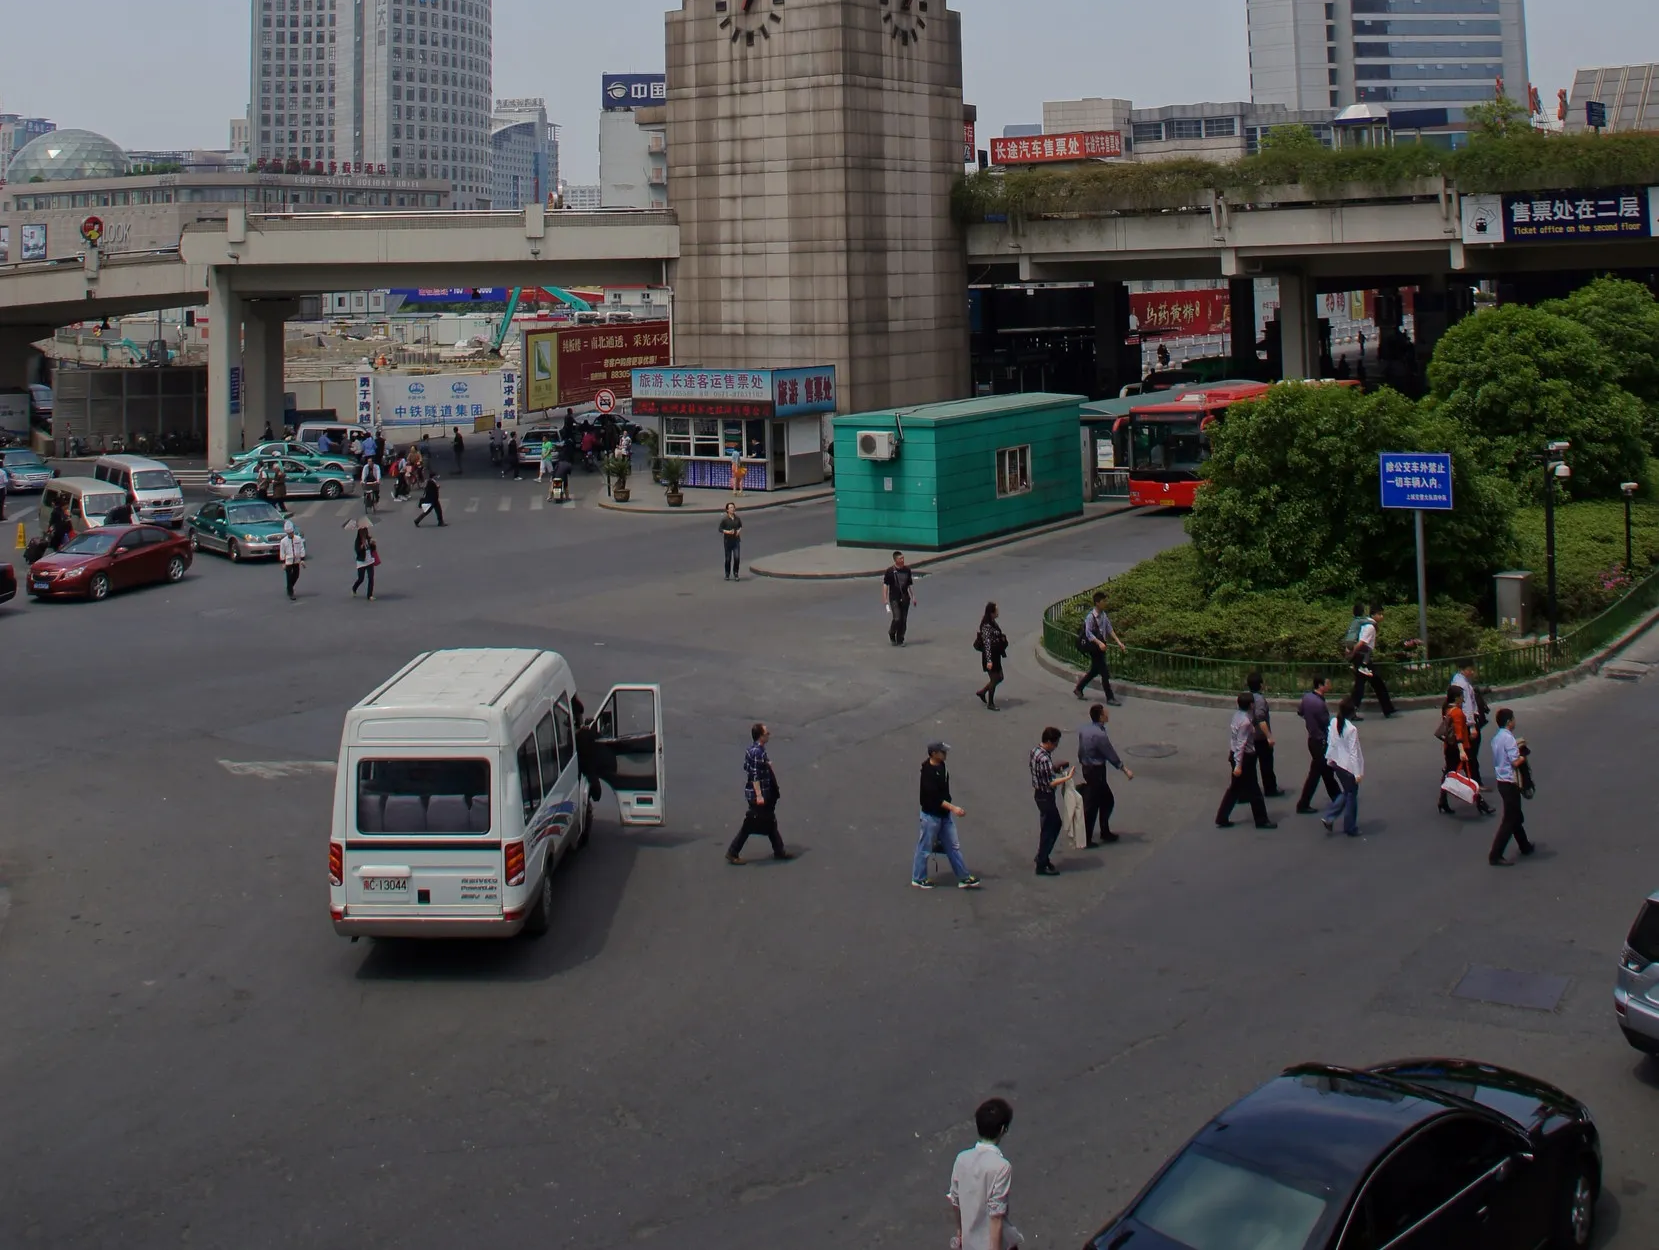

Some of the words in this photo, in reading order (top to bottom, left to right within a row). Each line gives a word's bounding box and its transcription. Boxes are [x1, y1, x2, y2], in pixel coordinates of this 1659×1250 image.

[631, 82, 666, 99] 中国
[995, 137, 1080, 160] 长途汽车售票处
[1085, 134, 1120, 153] 长途汽车售票处
[1510, 197, 1640, 223] 售票处在二层
[1513, 226, 1537, 235] Ticket
[1540, 225, 1564, 234] office
[1579, 224, 1591, 232] the
[1594, 223, 1618, 231] second
[1621, 222, 1641, 230] floor
[639, 373, 764, 389] 旅游、长途客运售票处
[359, 376, 371, 424] 勇于跨越
[503, 373, 516, 420] 追求卓越
[777, 379, 799, 406] 旅游
[804, 376, 833, 403] 售票处
[394, 403, 483, 418] 中铁隧道集团
[1385, 461, 1446, 474] 除公交车外禁止
